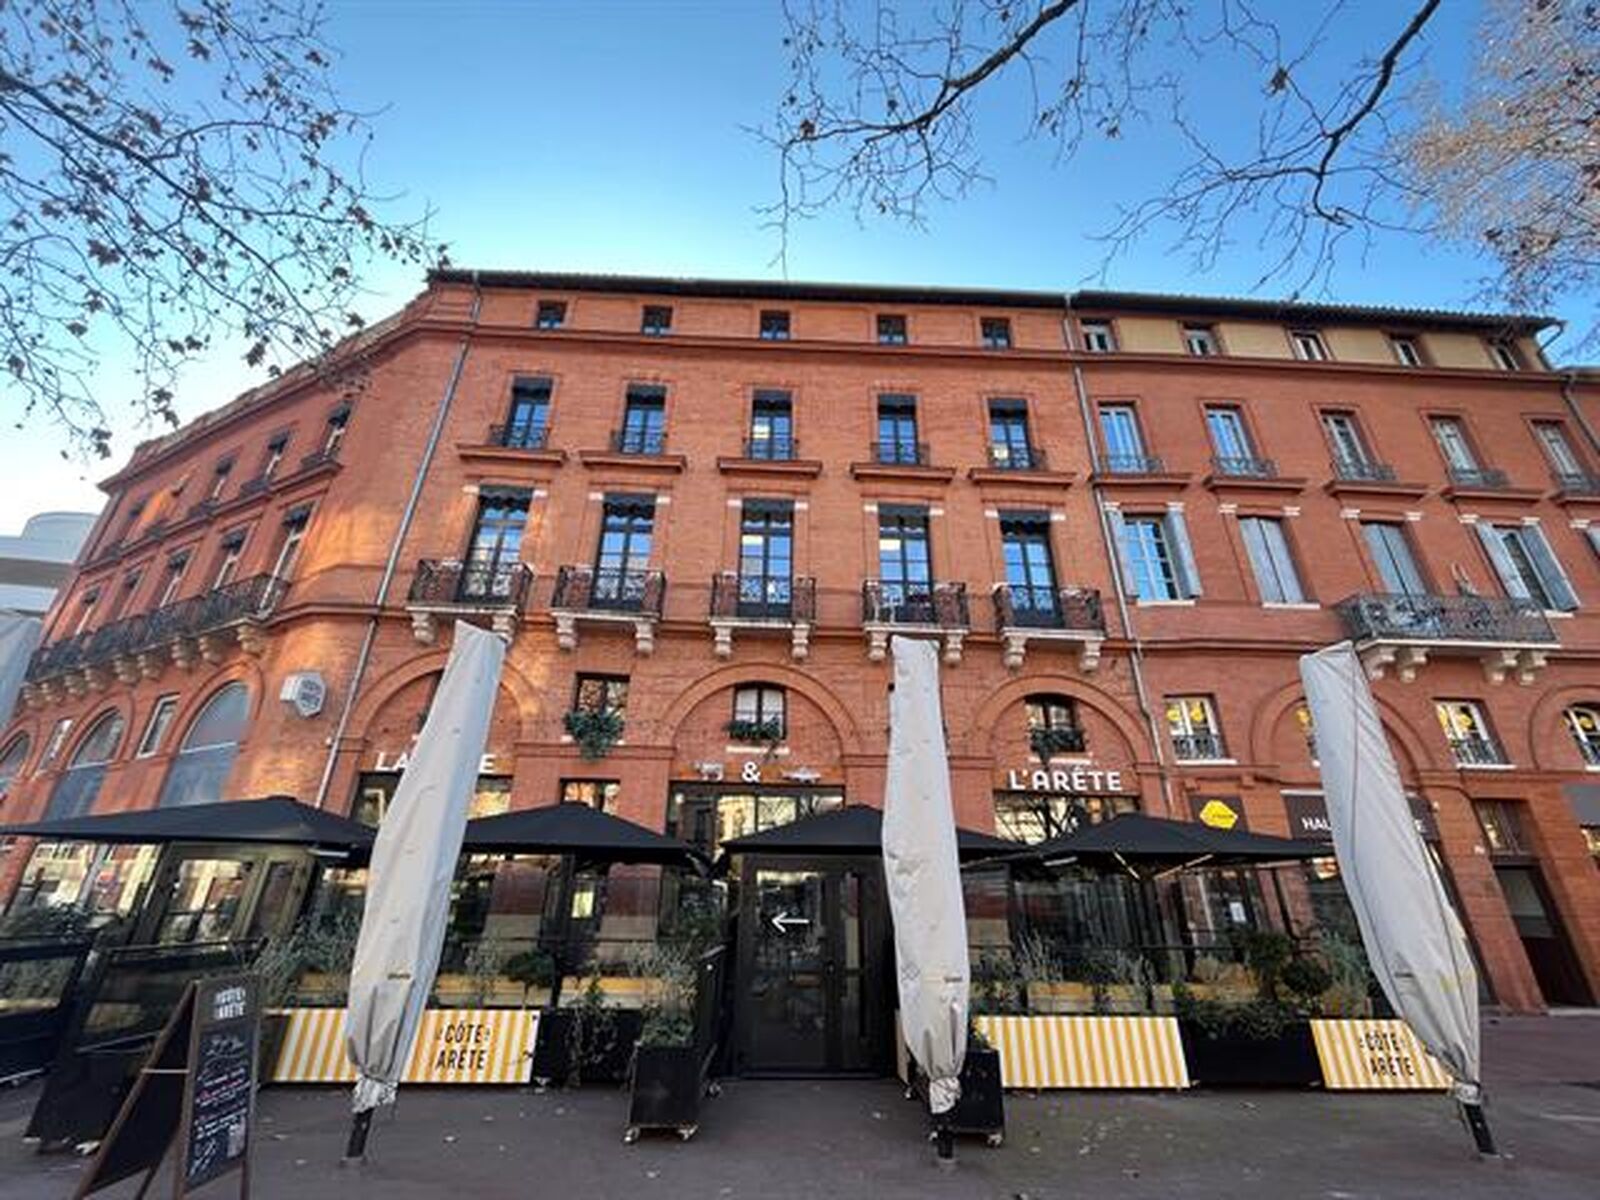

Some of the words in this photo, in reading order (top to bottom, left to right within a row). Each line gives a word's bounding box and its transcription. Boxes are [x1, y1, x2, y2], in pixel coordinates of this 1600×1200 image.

[742, 761, 761, 783] &
[1009, 765, 1122, 791] L'ARÊTE
[445, 1020, 484, 1043] CÔTE
